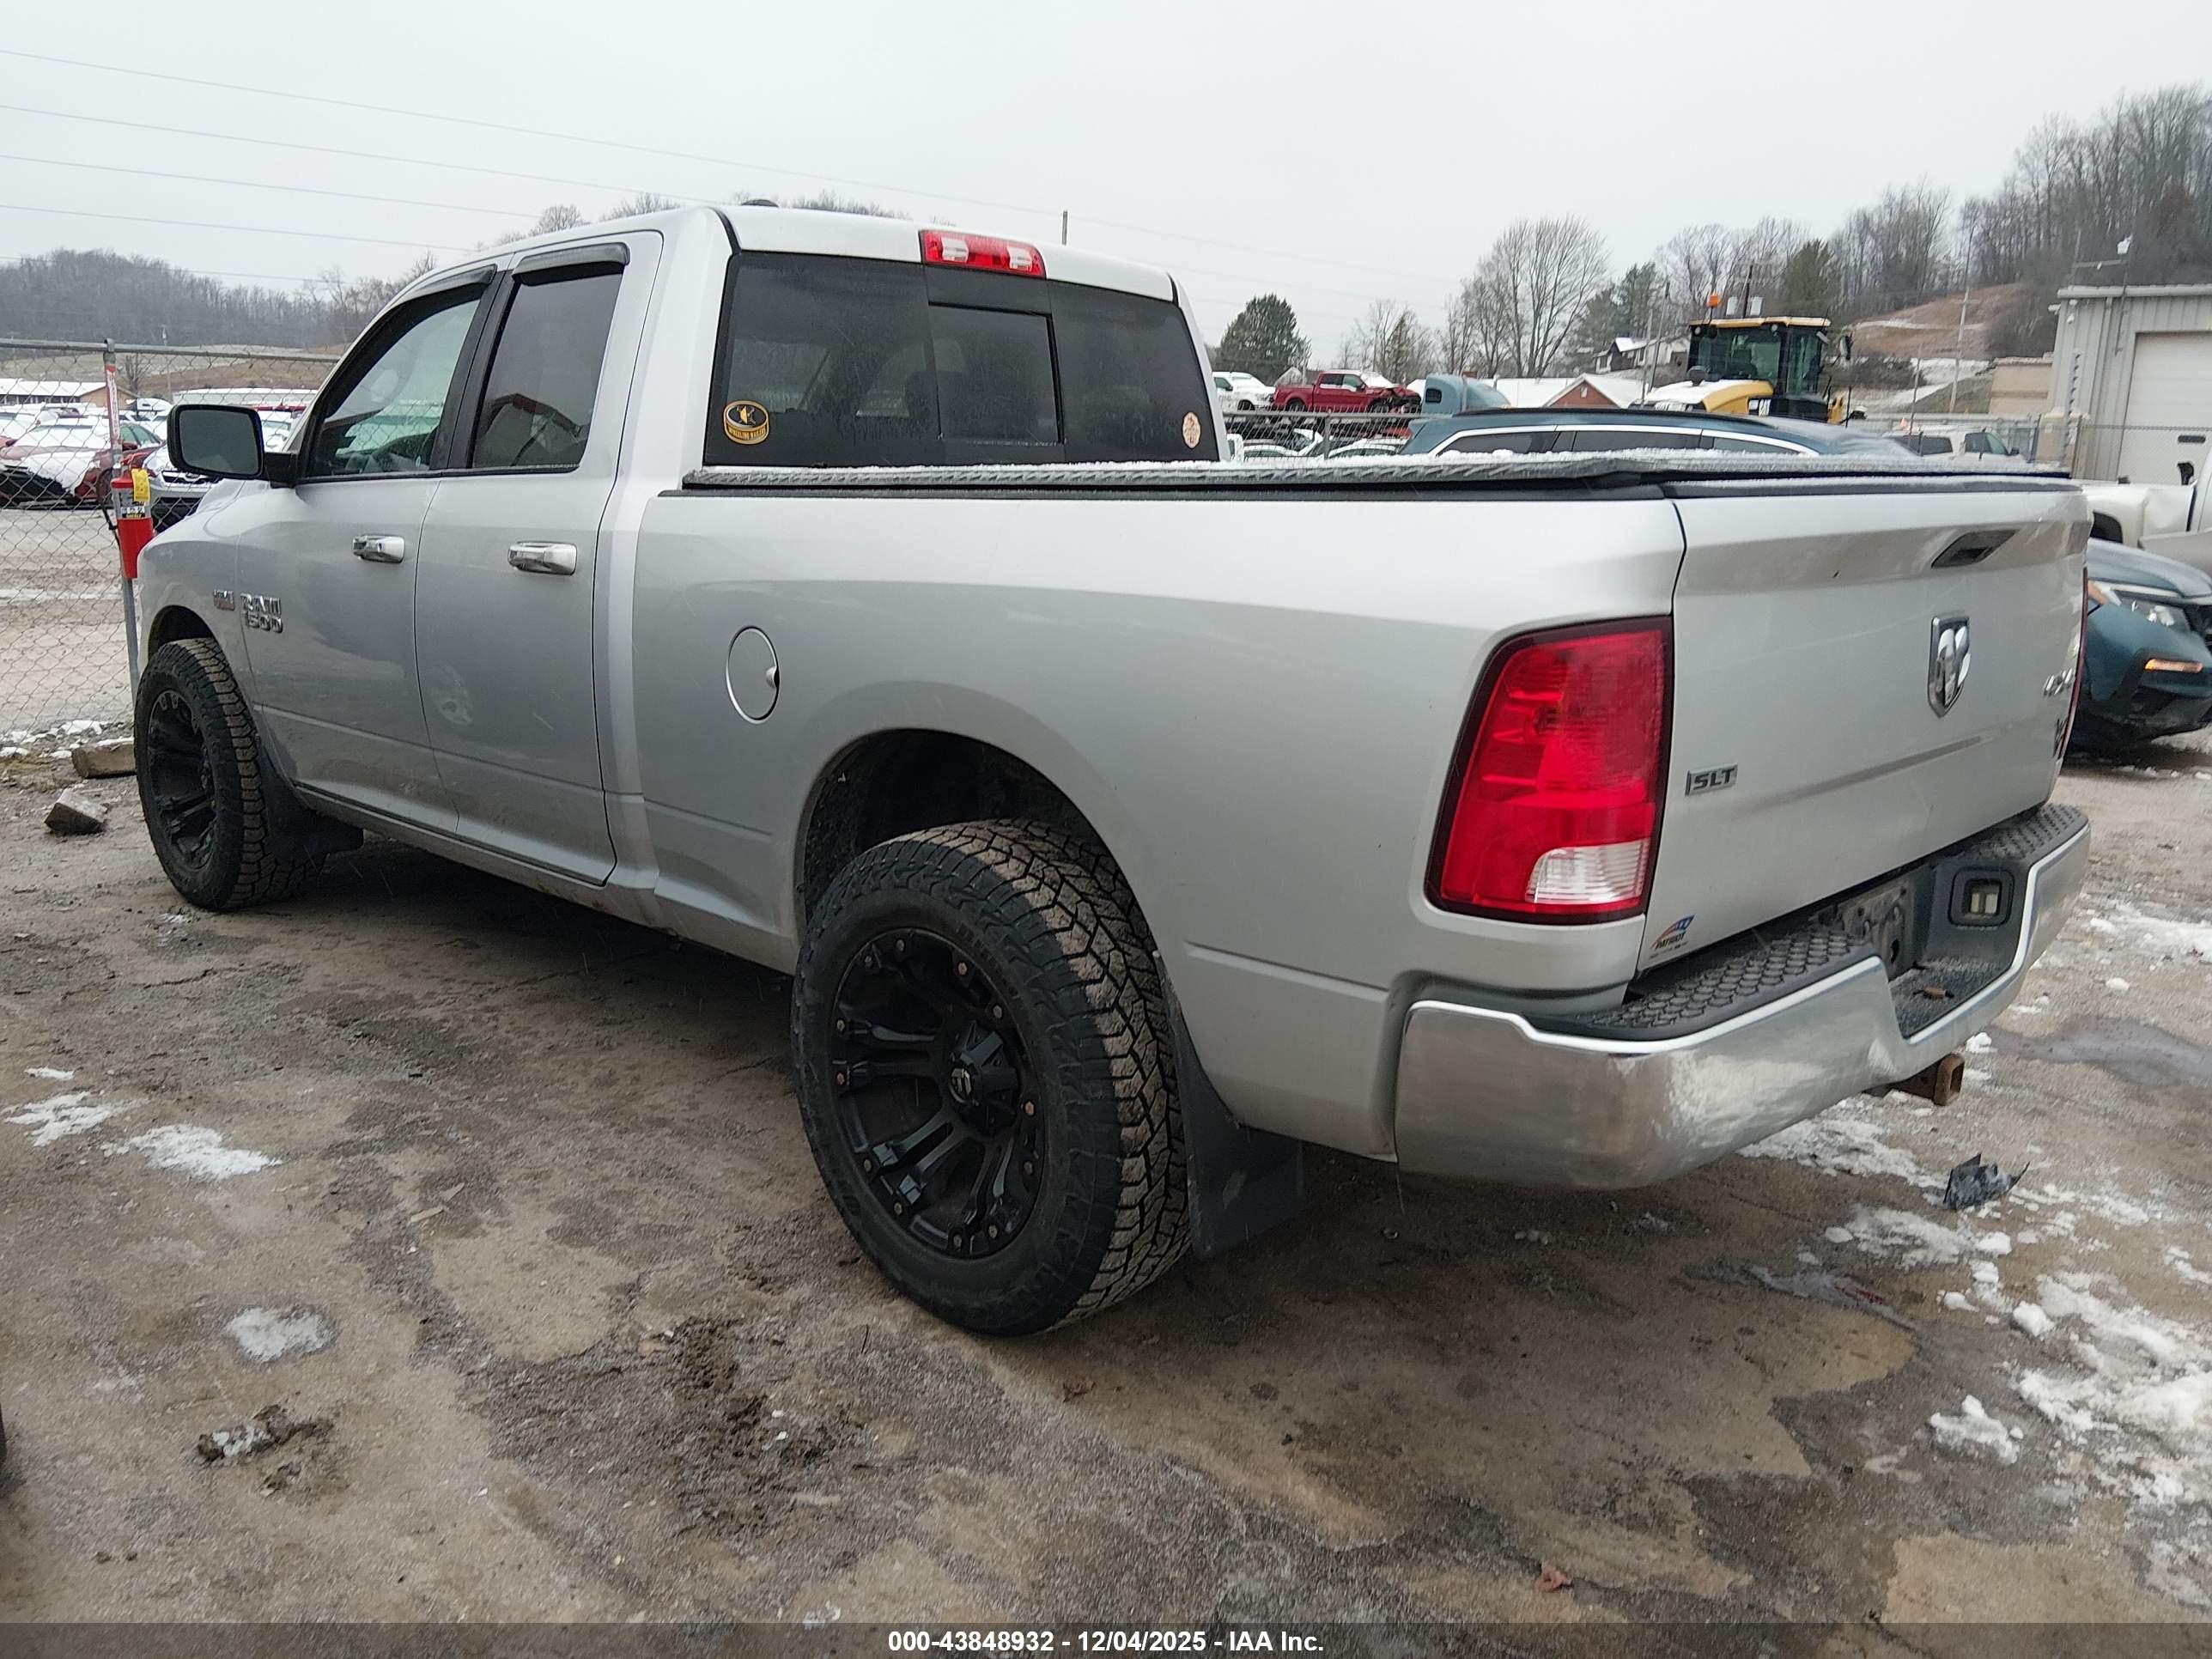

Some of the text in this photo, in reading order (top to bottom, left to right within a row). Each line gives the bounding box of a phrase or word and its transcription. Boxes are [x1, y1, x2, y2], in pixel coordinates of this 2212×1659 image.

[240, 592, 282, 616] RAM
[241, 611, 283, 633] 1500
[1693, 768, 1735, 790] SLT
